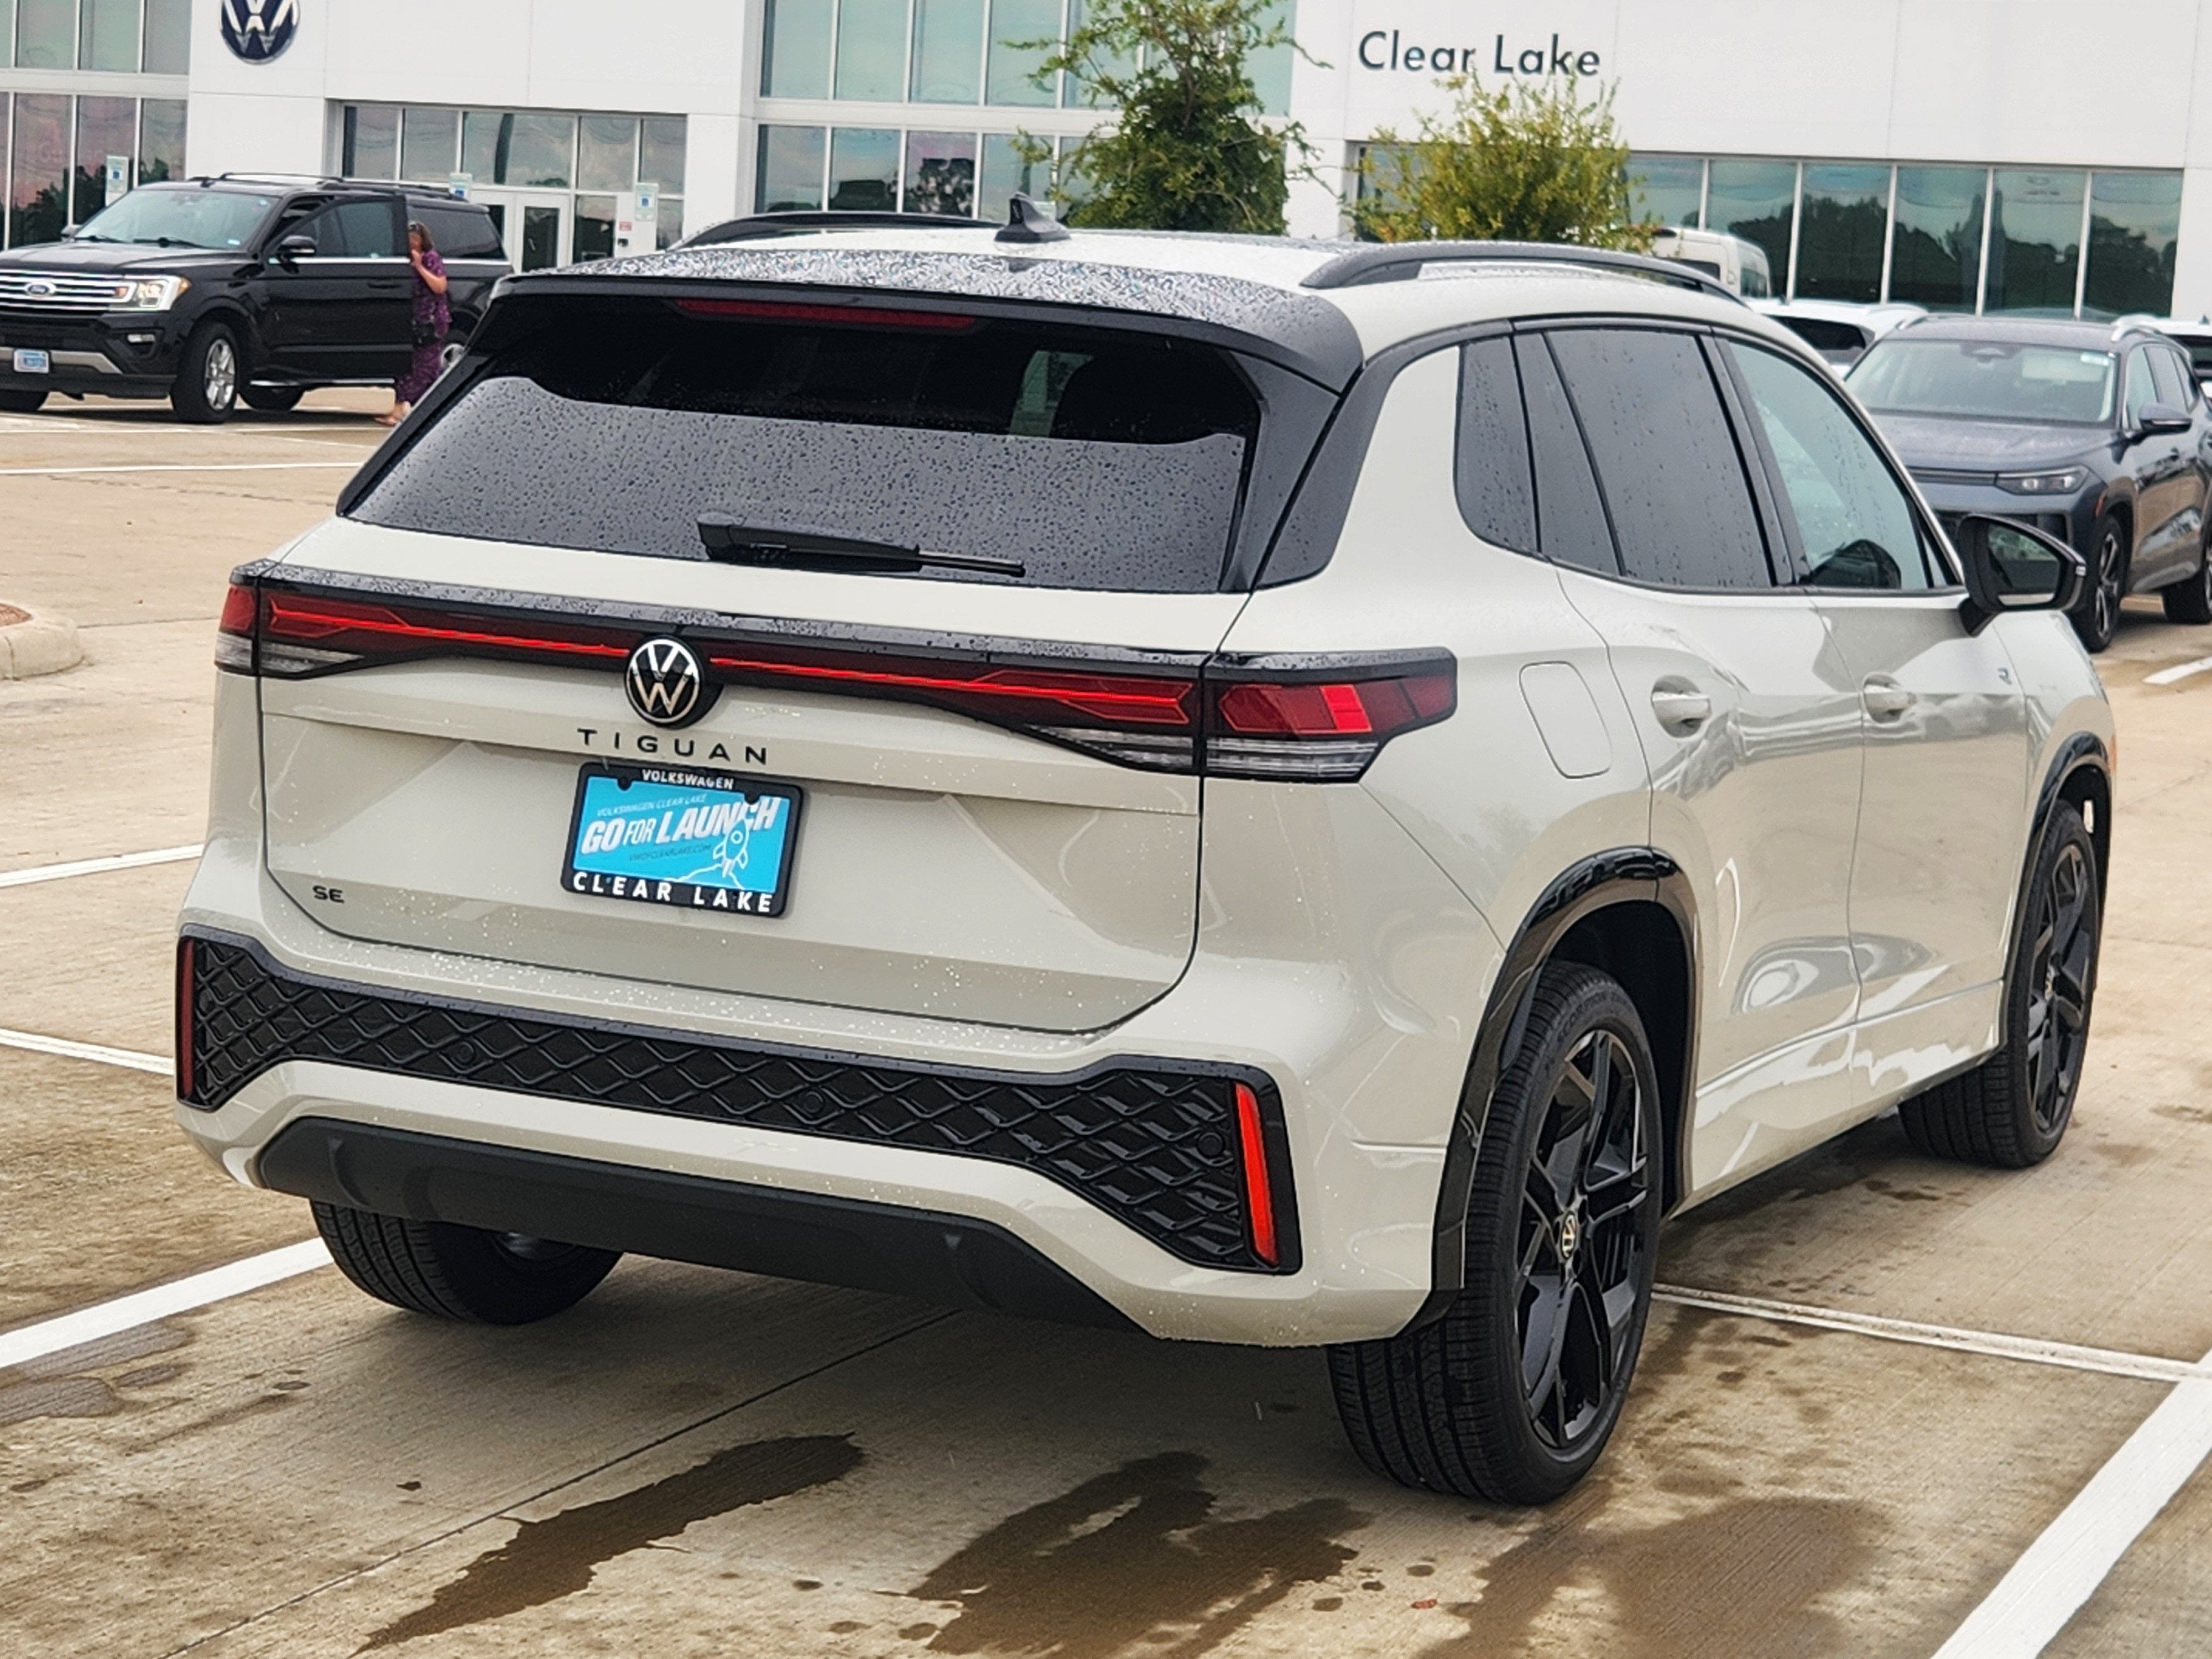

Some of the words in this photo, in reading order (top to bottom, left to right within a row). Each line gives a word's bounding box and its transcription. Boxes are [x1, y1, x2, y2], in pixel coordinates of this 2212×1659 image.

[1359, 29, 1476, 73] Clear
[1493, 33, 1600, 76] Lake
[577, 727, 766, 765] TIGUAN
[642, 768, 734, 790] VOLKSWAGEN
[656, 797, 684, 809] CLEAR
[685, 793, 707, 805] LAKE
[581, 817, 625, 855] GO
[623, 817, 657, 846] FOR
[655, 797, 782, 844] LAUNCH
[312, 885, 345, 904] SE
[573, 872, 672, 901] CLEAR
[693, 886, 774, 913] LAKE
